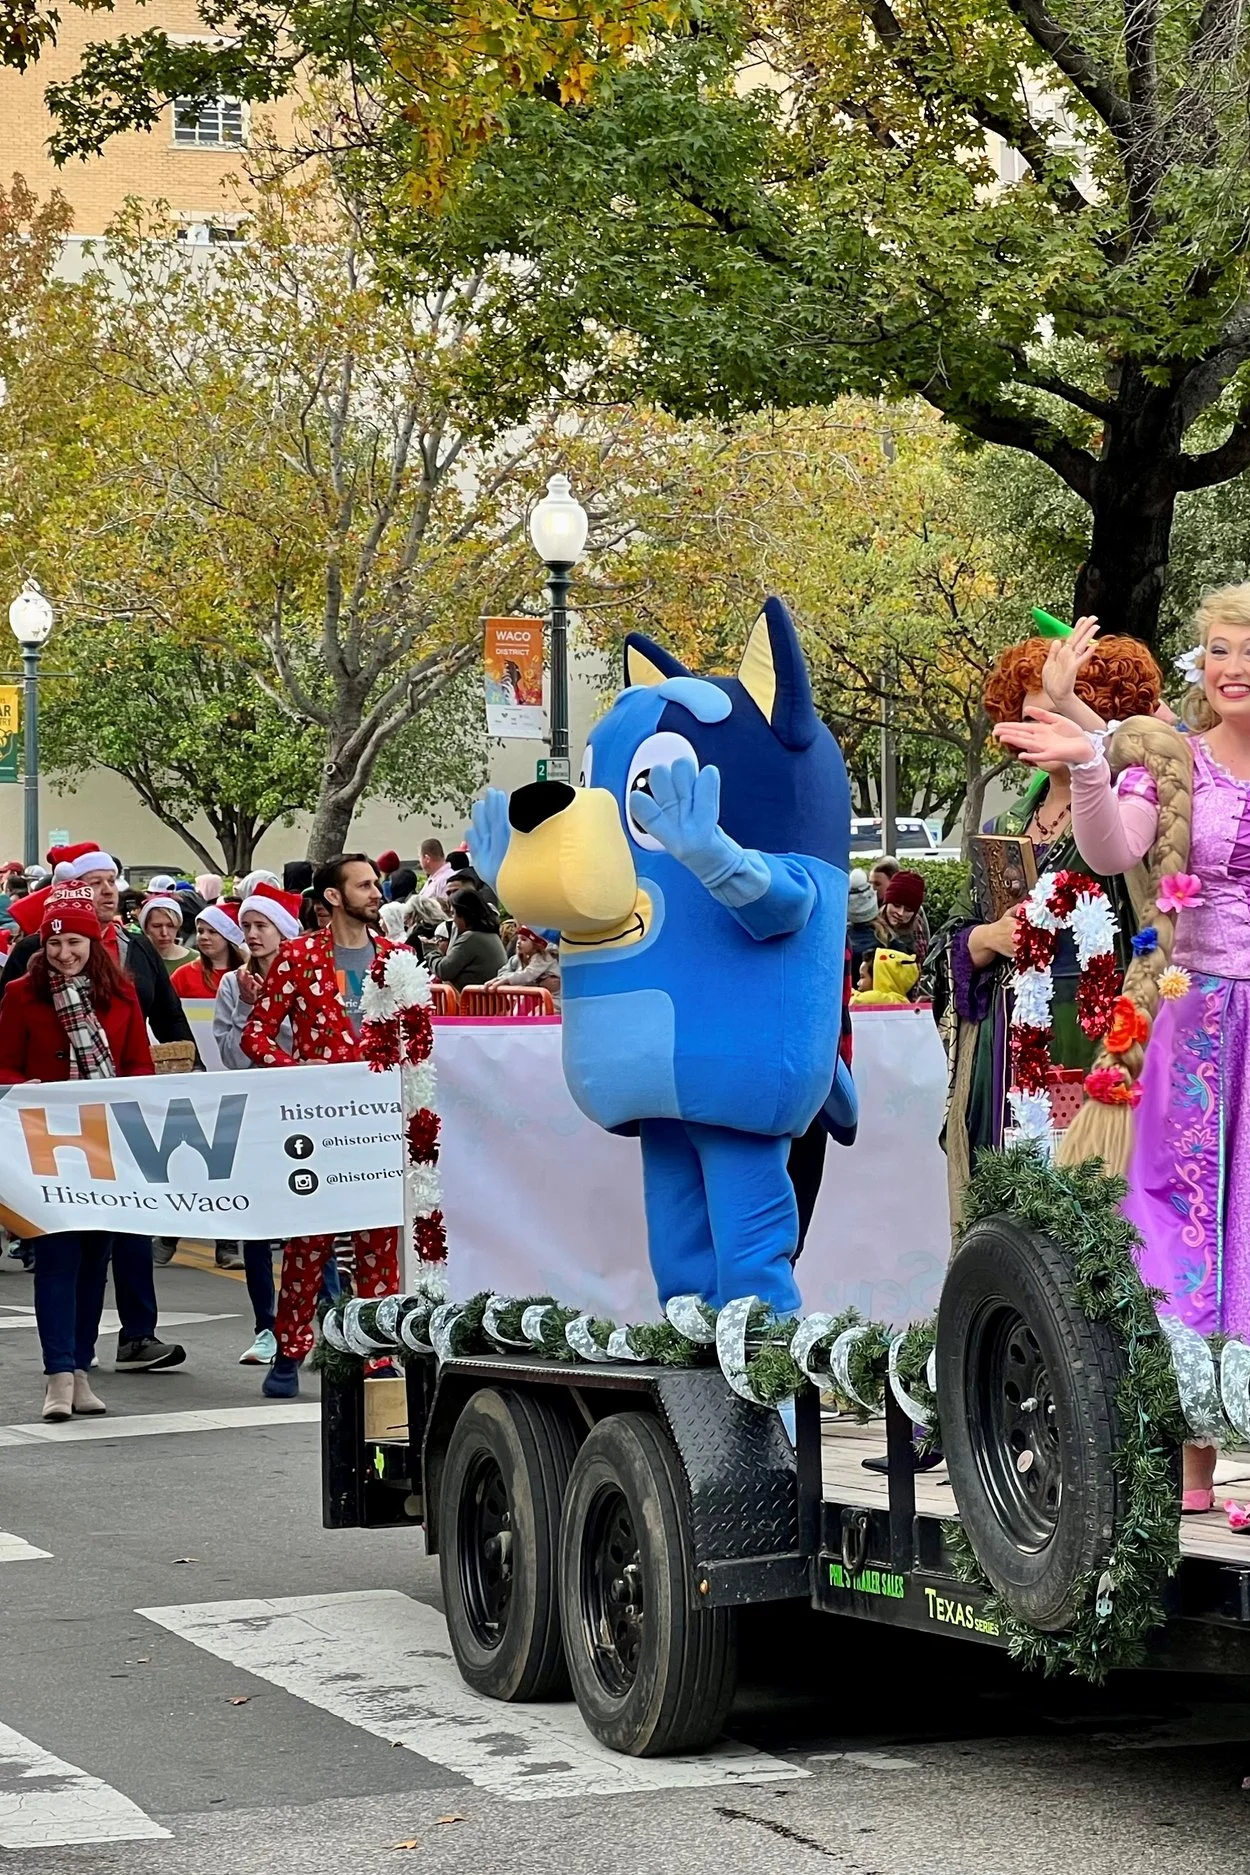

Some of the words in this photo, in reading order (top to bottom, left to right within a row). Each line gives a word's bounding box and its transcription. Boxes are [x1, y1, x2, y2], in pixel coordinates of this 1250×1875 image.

[495, 630, 532, 642] WACO
[495, 648, 530, 656] DISTRICT
[538, 764, 546, 776] 2
[18, 1093, 249, 1183] HW
[41, 1185, 158, 1210] Historic
[165, 1193, 250, 1212] Waco
[881, 1573, 905, 1599] SALES
